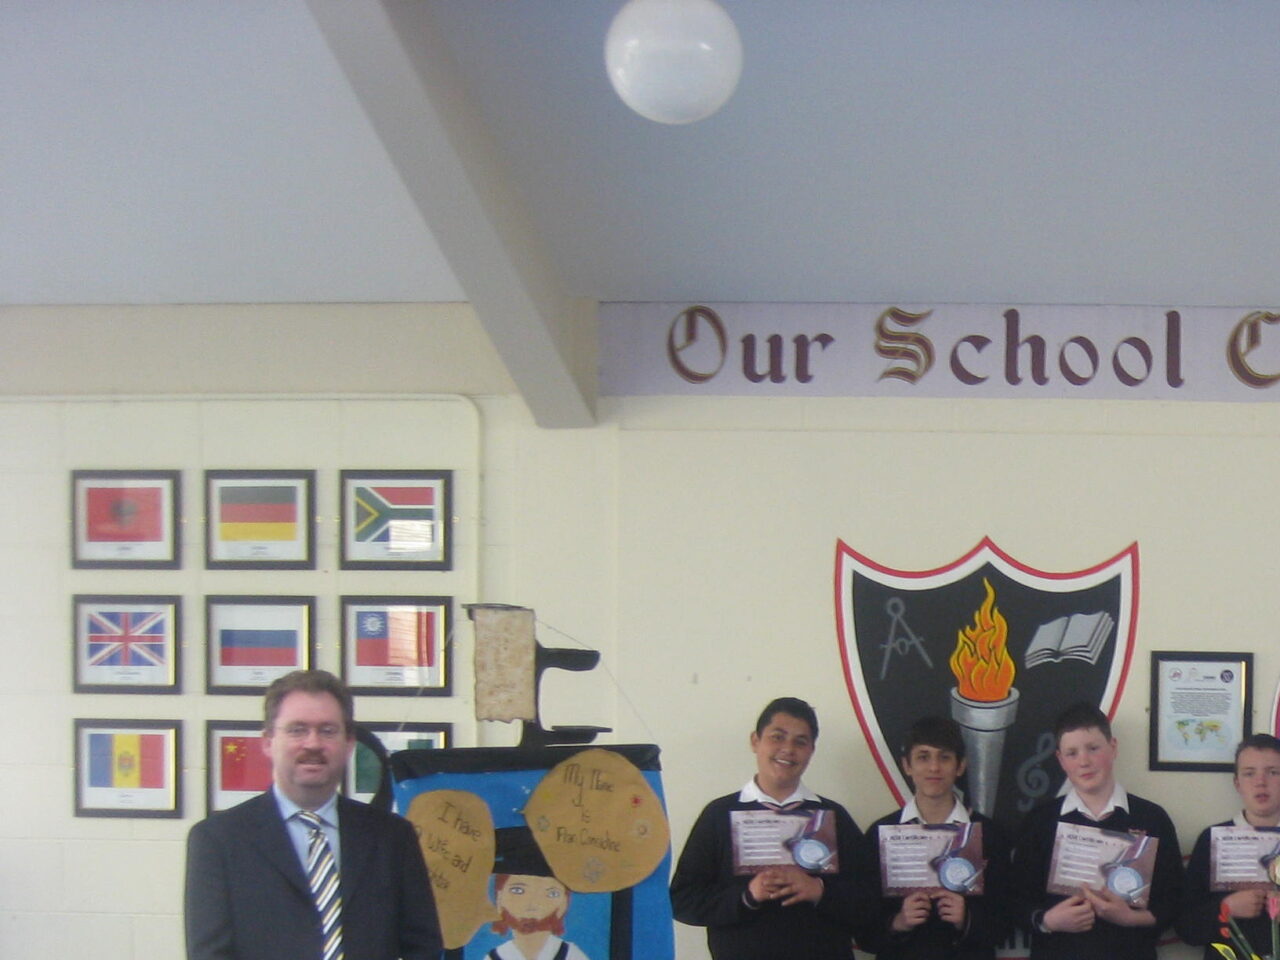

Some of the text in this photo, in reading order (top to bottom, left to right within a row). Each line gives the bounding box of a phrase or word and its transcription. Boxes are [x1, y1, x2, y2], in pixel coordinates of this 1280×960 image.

[666, 305, 832, 384] Our
[873, 307, 1185, 388] School
[438, 801, 482, 842] I have
